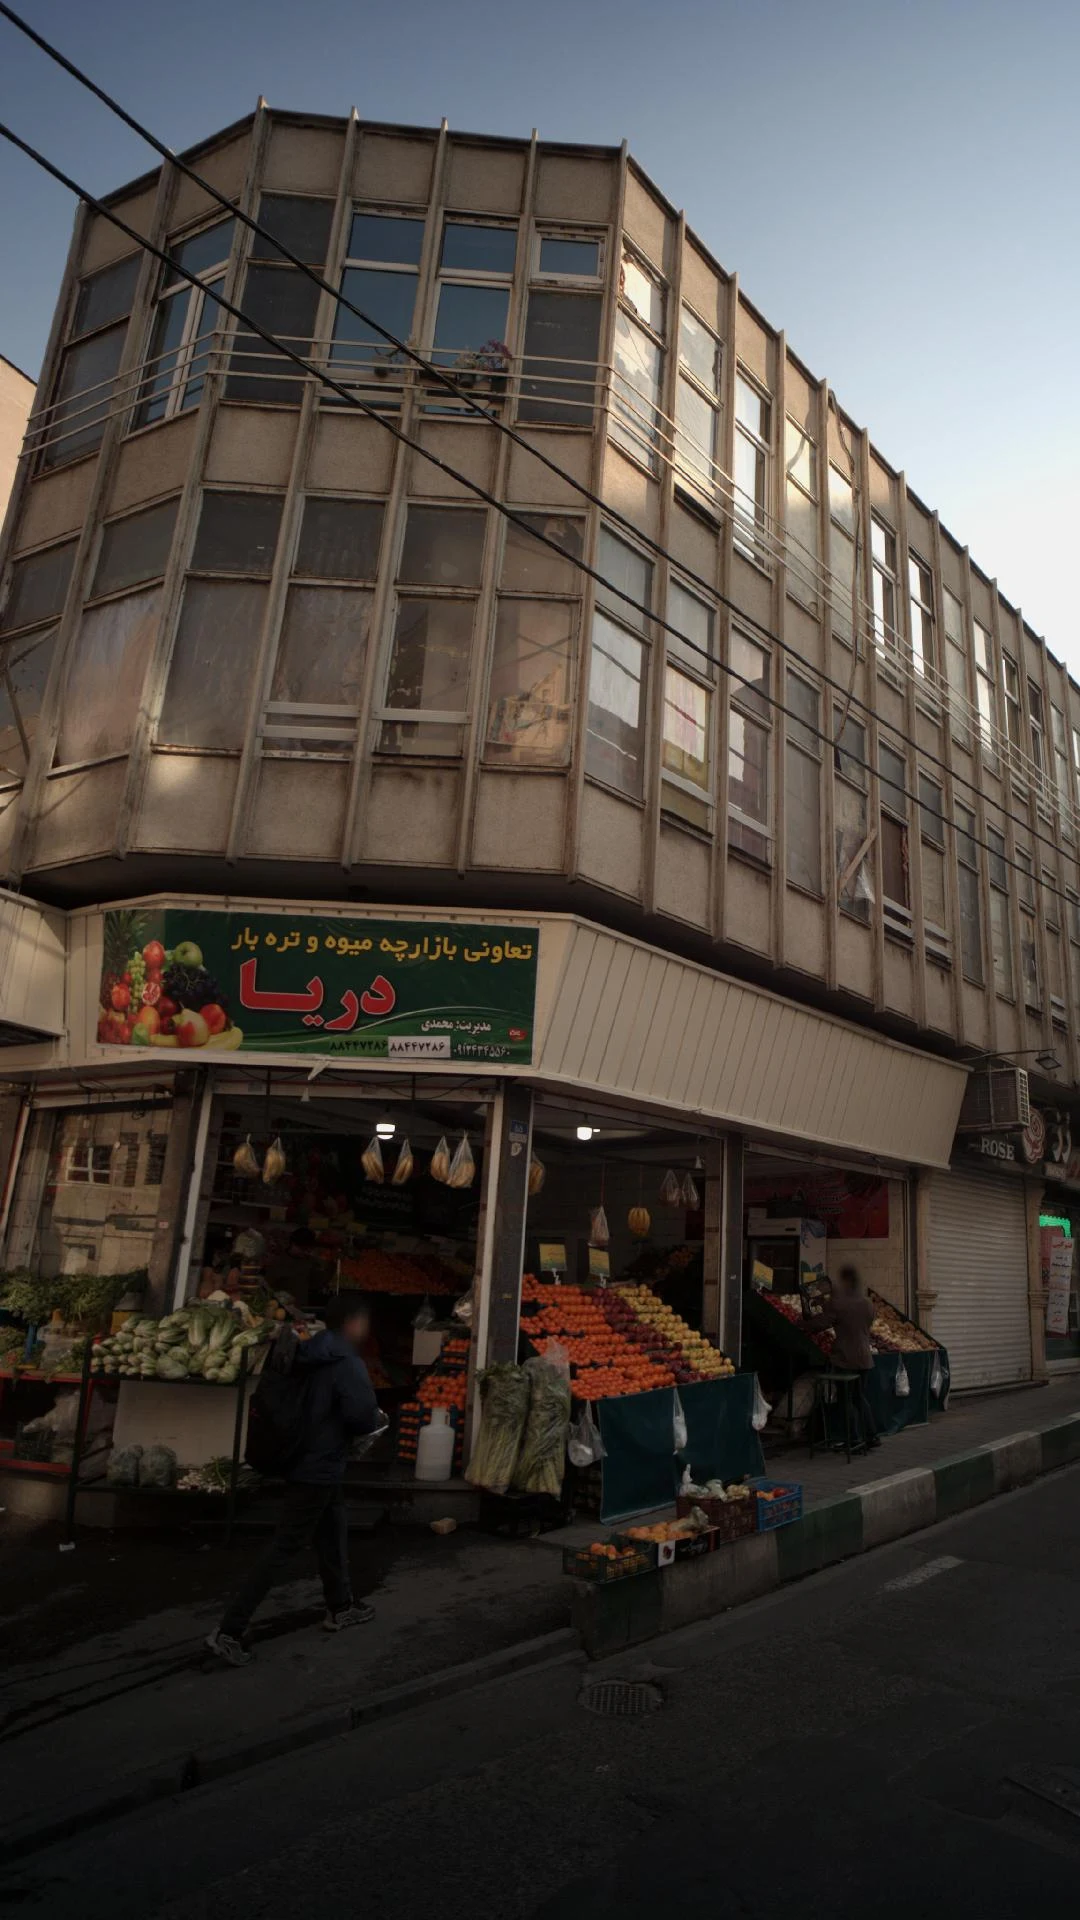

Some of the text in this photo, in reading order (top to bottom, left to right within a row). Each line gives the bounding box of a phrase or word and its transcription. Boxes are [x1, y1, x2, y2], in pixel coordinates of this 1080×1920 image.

[231, 927, 533, 963] تعاونی بازارچه میوه و تره بار
[239, 957, 397, 1031] دریا
[421, 1019, 454, 1032] محمدی
[390, 1041, 445, 1052] ۸۸۴۴۷۲۸۶
[981, 1136, 1015, 1161] ROSE
